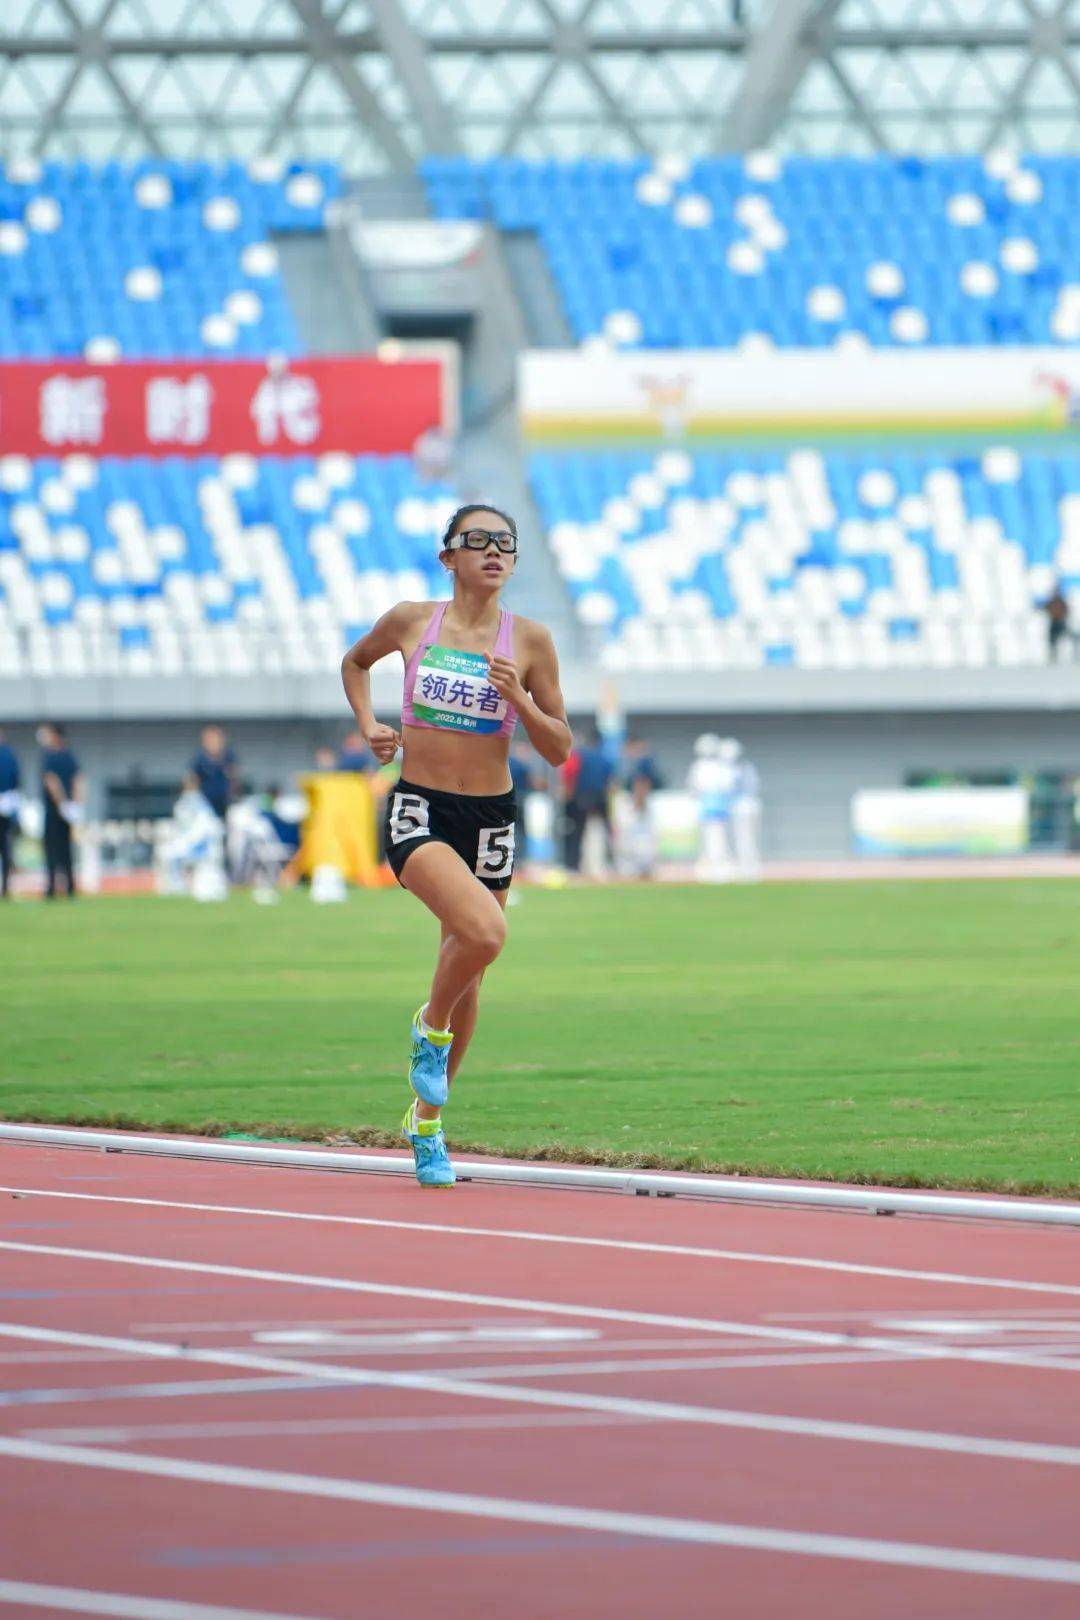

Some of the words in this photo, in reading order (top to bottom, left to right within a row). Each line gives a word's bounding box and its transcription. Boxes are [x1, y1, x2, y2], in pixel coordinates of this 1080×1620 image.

[422, 673, 503, 714] 领先者
[435, 713, 462, 725] 2022.8
[397, 798, 421, 834] 5
[483, 829, 510, 872] 5
